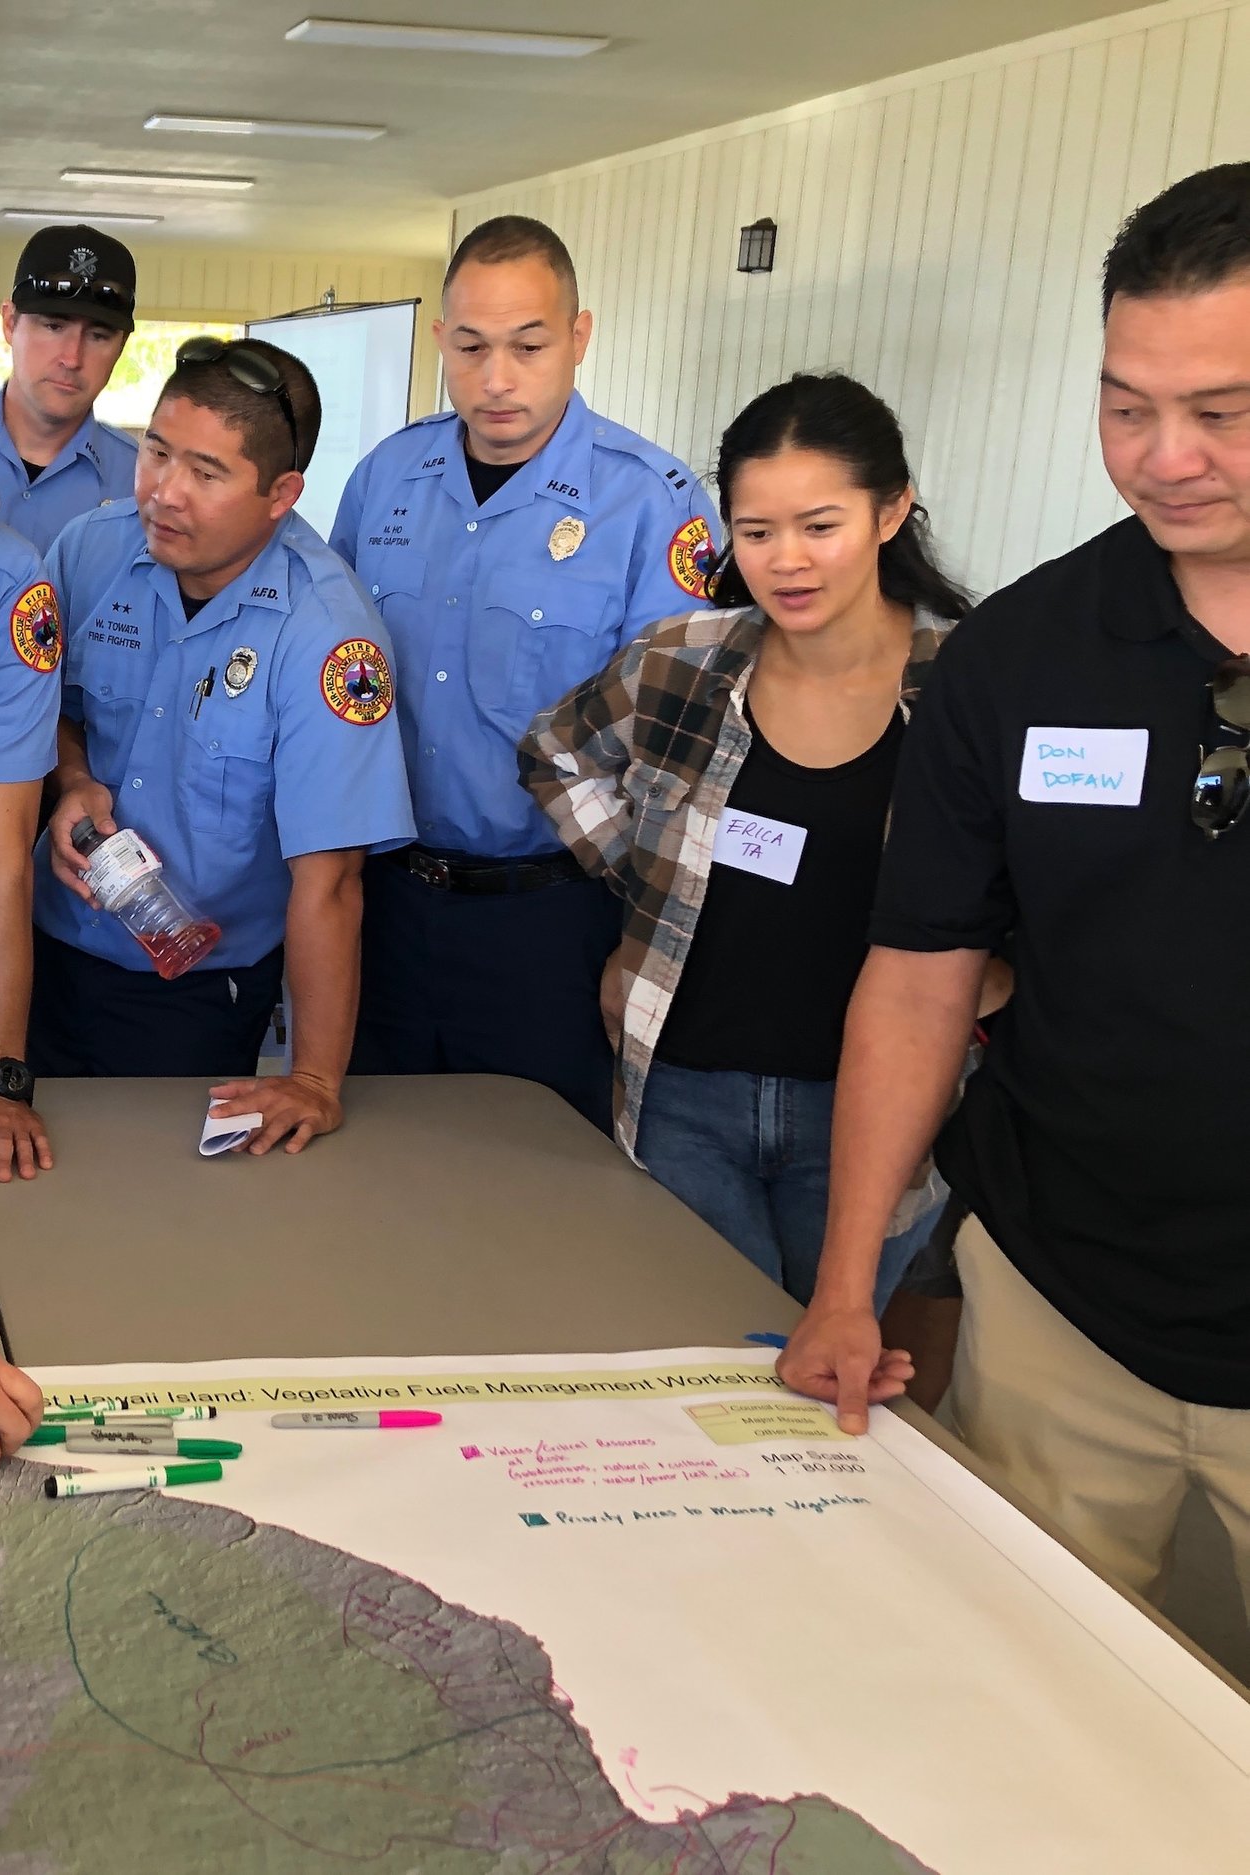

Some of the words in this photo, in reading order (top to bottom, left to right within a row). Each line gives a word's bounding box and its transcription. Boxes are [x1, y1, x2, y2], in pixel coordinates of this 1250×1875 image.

[421, 456, 446, 470] H.F.D.
[546, 479, 580, 500] H.F.D.
[392, 525, 403, 534] HO
[686, 521, 707, 538] FIR
[368, 537, 382, 546] FIRE
[383, 537, 411, 547] CAPTAIN
[25, 588, 48, 607] FIRE
[251, 587, 279, 601] H.F.D.
[95, 618, 105, 629] W.
[107, 620, 139, 636] TOWATA
[15, 617, 36, 661] AIR-RESCUE
[88, 630, 106, 643] FIRE
[106, 634, 141, 650] FIGHTER
[344, 642, 371, 654] FIRE
[325, 661, 344, 708] AIR-RESCUE
[1037, 743, 1085, 760] DON
[1042, 770, 1124, 790] DOFAW
[726, 819, 784, 847] ERICA
[741, 842, 764, 860] TA
[167, 1389, 254, 1404] Island:
[260, 1386, 401, 1403] Vegetative
[406, 1383, 480, 1398] Fuels
[485, 1379, 654, 1395] Management
[656, 1372, 785, 1390] Workshop
[741, 1417, 774, 1425] Major
[776, 1416, 816, 1425] Roads
[754, 1429, 788, 1437] Other
[789, 1428, 829, 1437] Roads
[761, 1452, 802, 1465] Map
[555, 1510, 624, 1526] Priority
[632, 1510, 677, 1521] Areas
[710, 1506, 776, 1518] Manage
